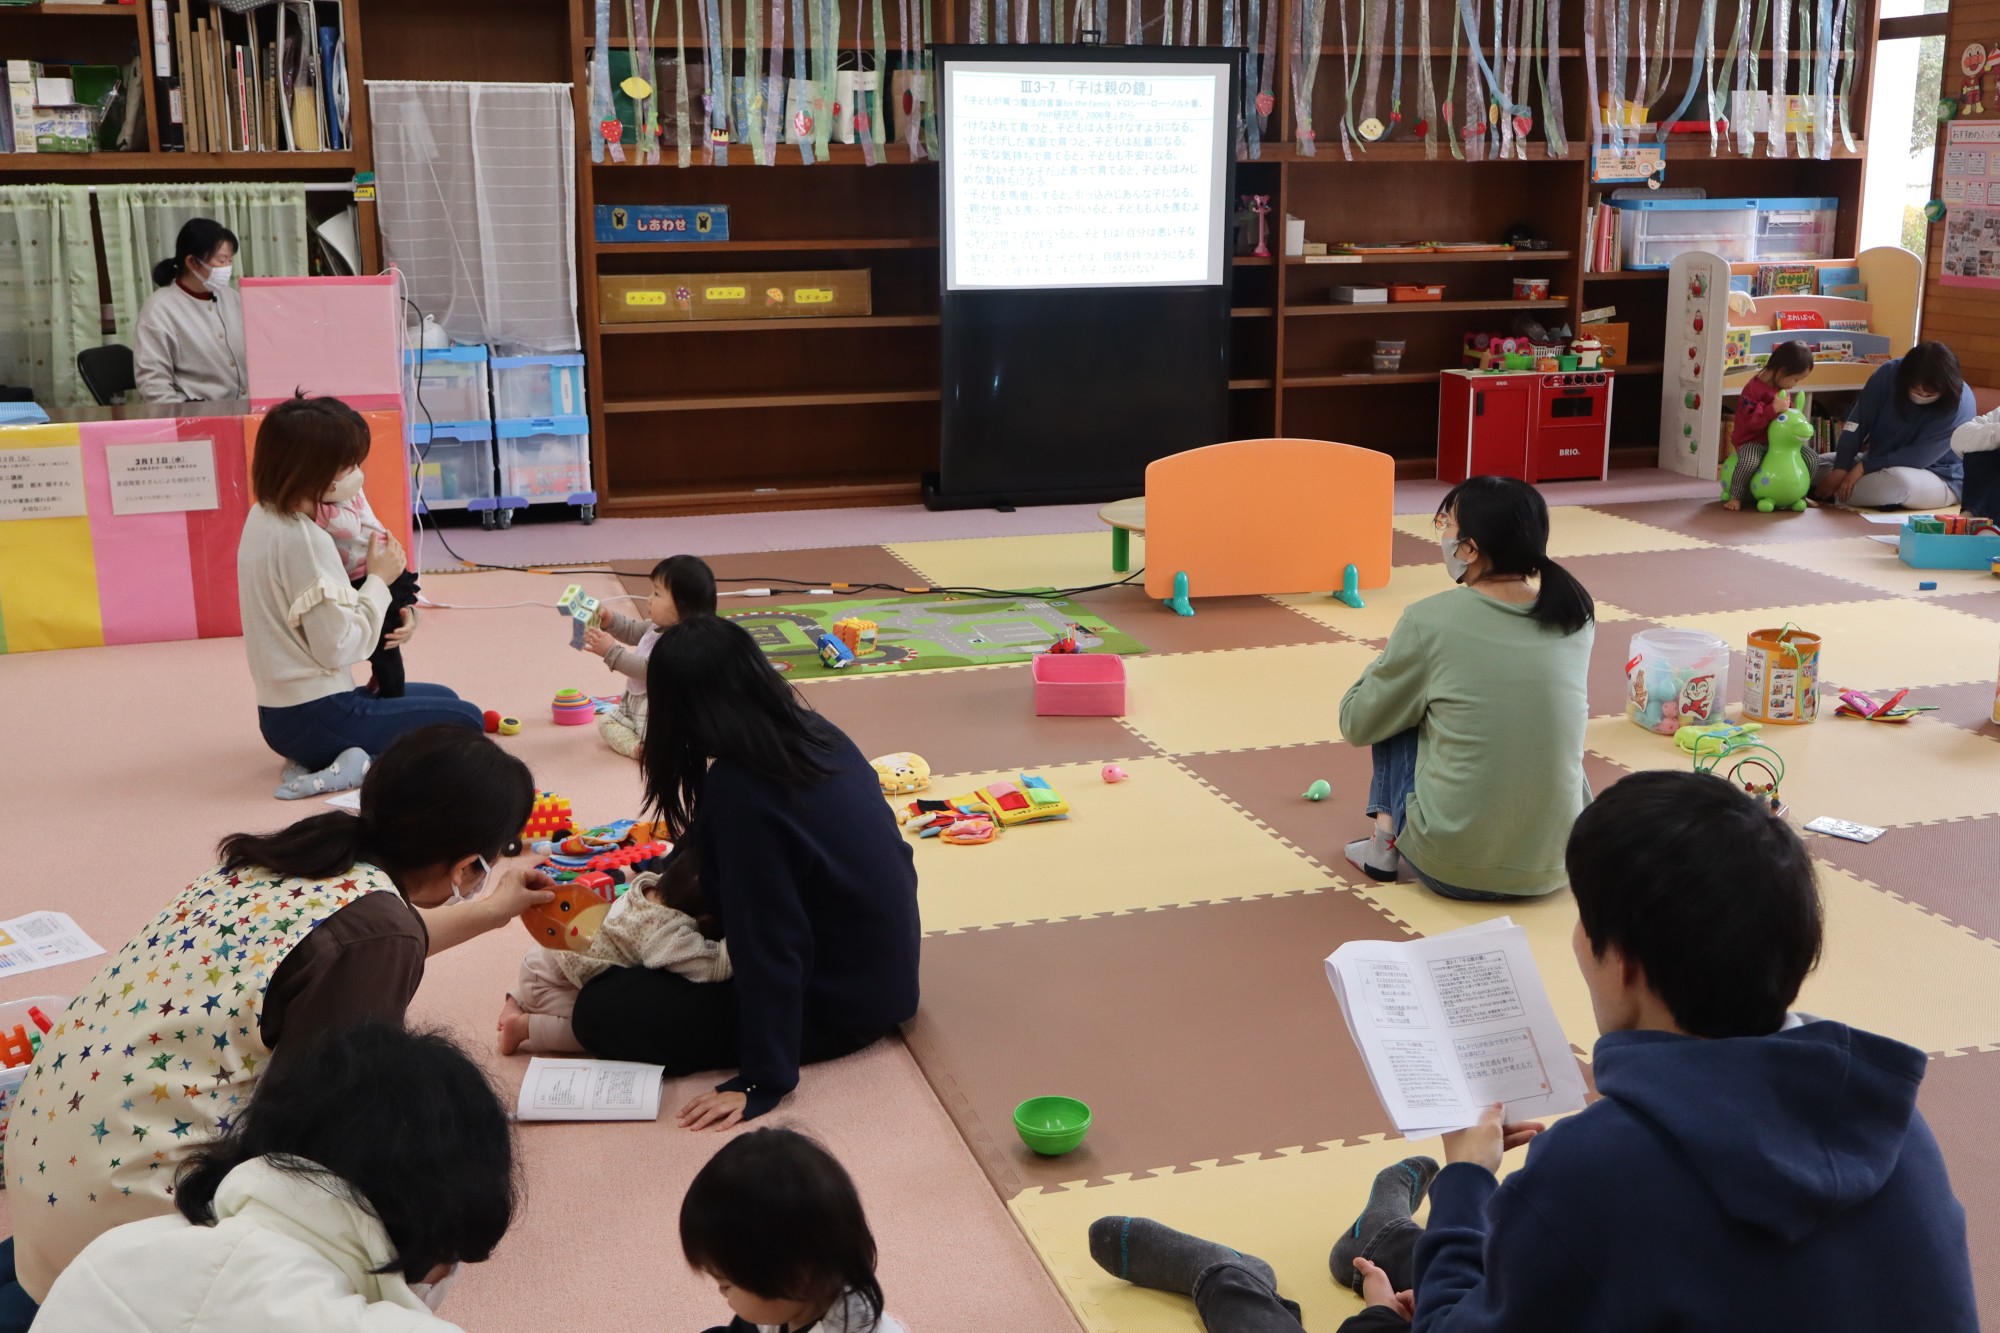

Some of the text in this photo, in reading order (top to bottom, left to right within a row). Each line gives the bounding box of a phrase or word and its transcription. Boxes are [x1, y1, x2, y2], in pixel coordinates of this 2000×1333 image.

[637, 218, 687, 231] しあわせ
[1559, 448, 1580, 456] BRIO
